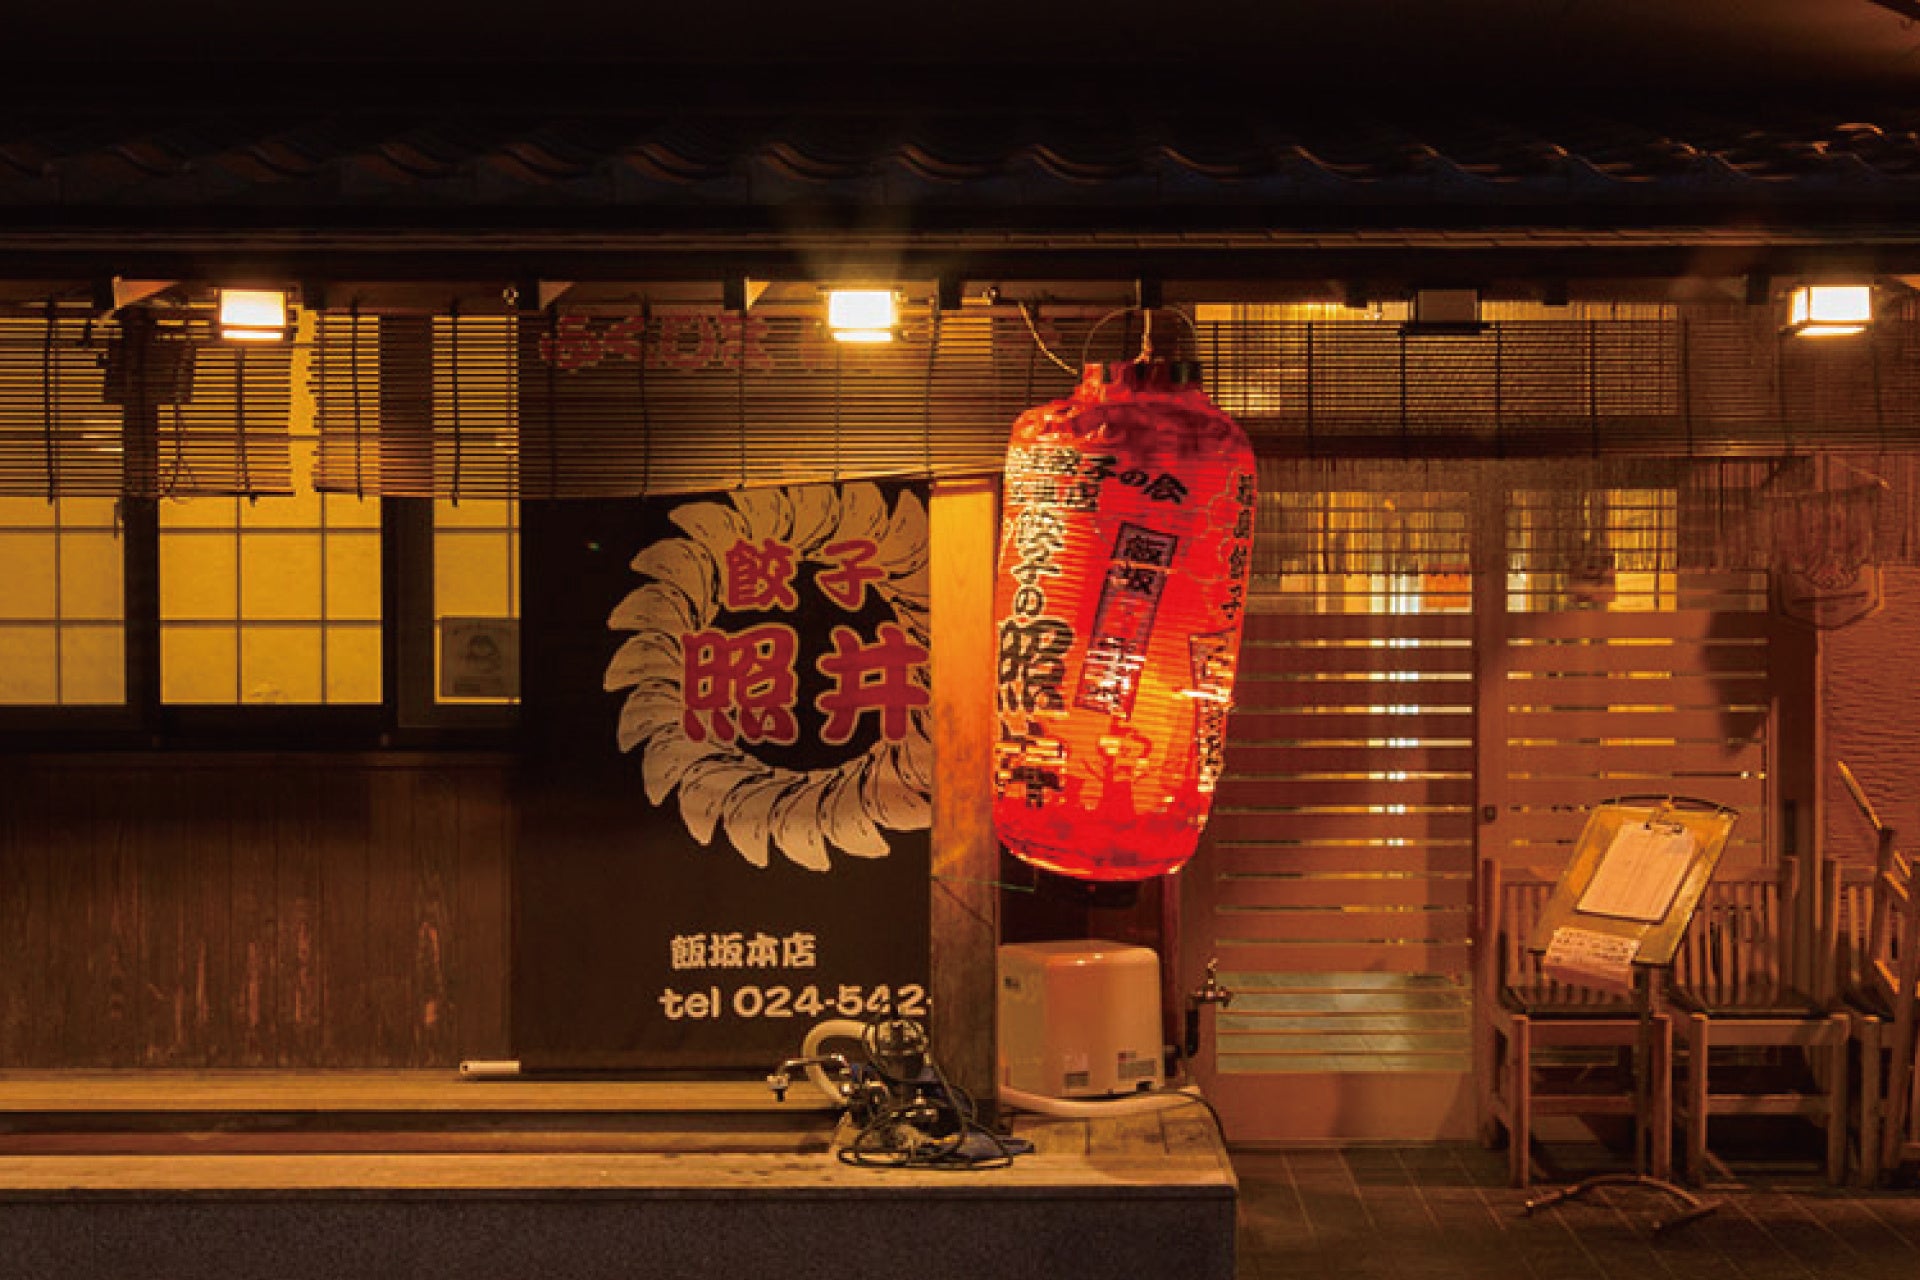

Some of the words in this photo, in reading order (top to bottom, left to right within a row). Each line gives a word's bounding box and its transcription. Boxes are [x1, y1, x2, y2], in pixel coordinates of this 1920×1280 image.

[725, 538, 886, 610] 餃子
[682, 626, 931, 744] 照井
[671, 933, 817, 969] 飯坂本店
[659, 986, 720, 1018] tel
